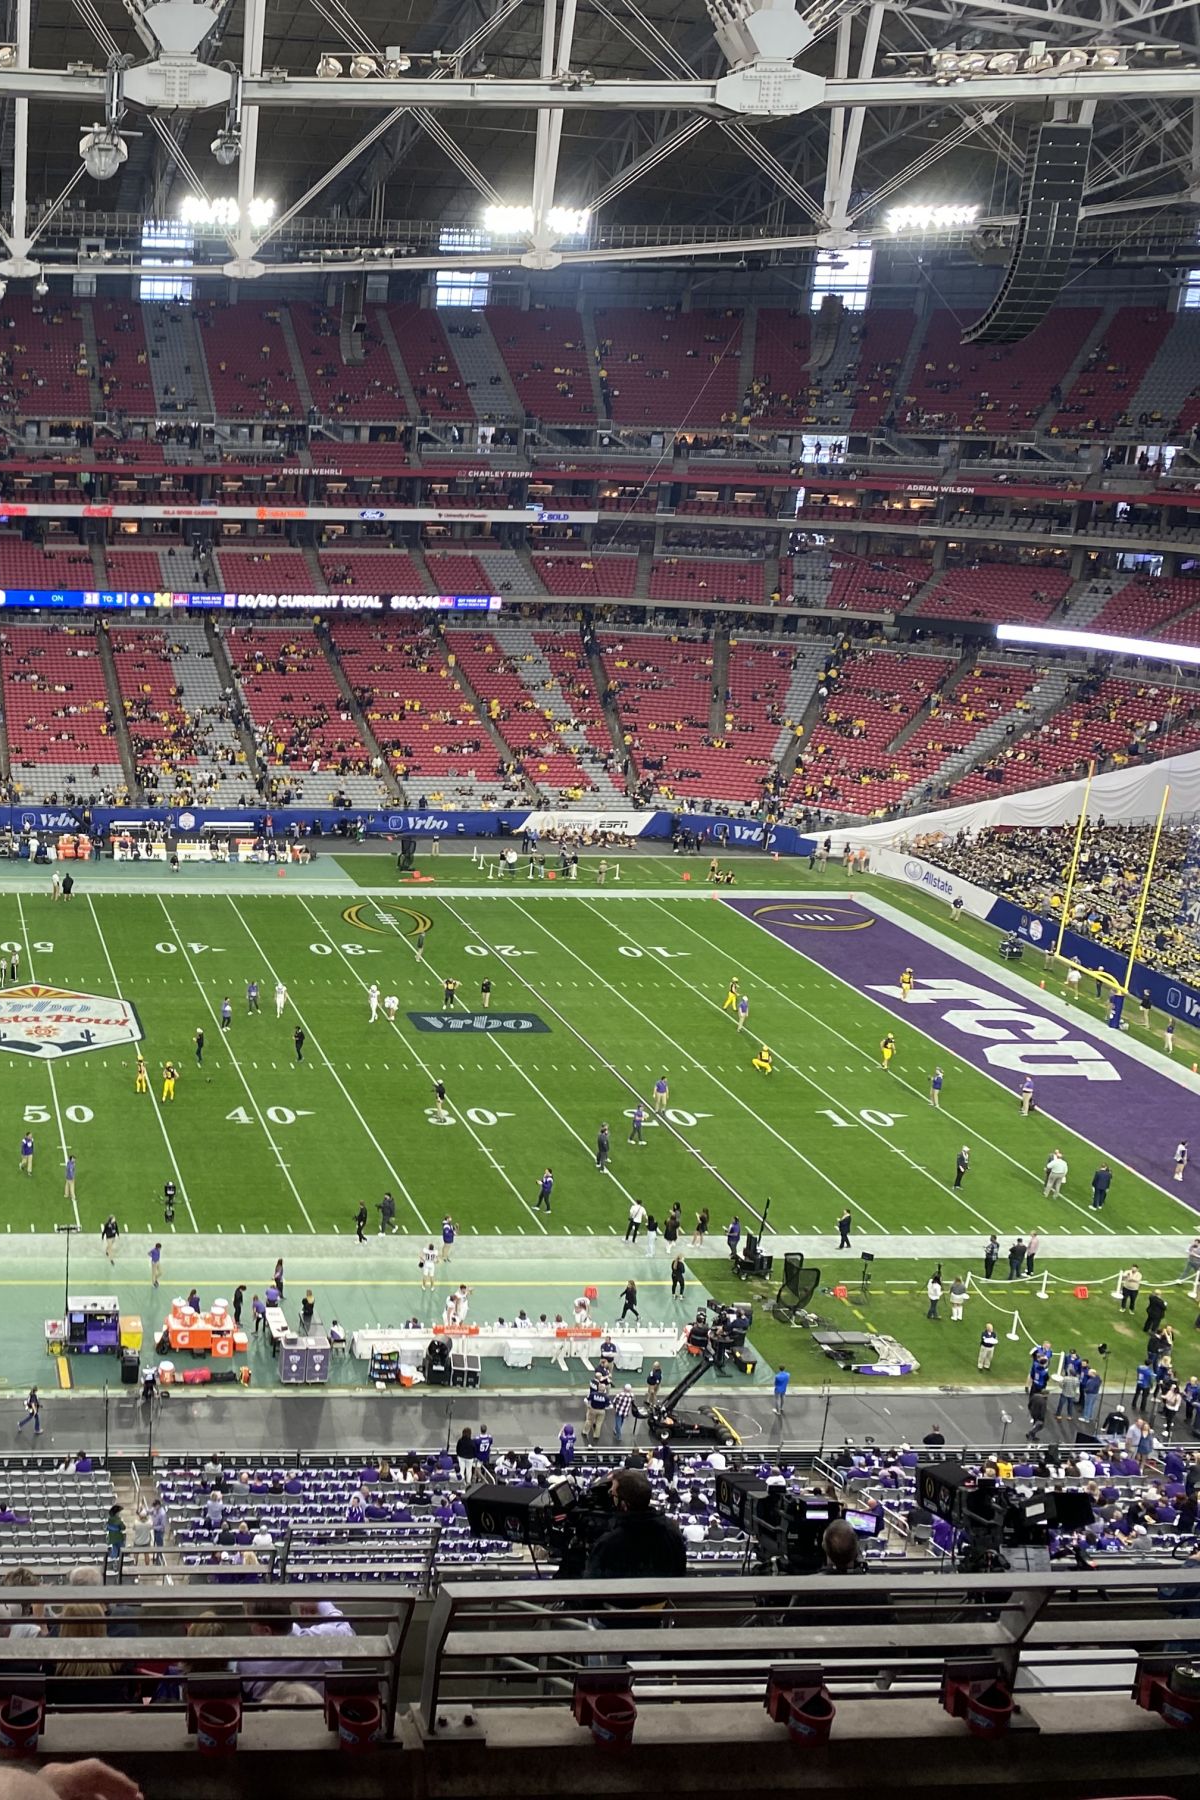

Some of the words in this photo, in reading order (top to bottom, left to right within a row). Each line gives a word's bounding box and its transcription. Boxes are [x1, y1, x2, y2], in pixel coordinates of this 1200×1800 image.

[906, 484, 938, 492] ADRIAN
[363, 511, 382, 519] Ford
[51, 594, 64, 602] ON
[237, 594, 277, 608] 50/50
[278, 595, 340, 608] CURRENT
[341, 595, 383, 608] TOTAL
[407, 815, 449, 830] Vrbo
[598, 820, 629, 829] ESPN
[922, 871, 953, 896] Allstate
[0, 941, 55, 953] 50
[155, 941, 210, 955] 40
[309, 943, 367, 956] 30
[464, 944, 523, 957] 20
[618, 945, 683, 959] 10
[46, 1014, 131, 1027] Bowl
[421, 1015, 534, 1029] Vrbo
[864, 978, 1122, 1081] TCU
[22, 1105, 95, 1124] 50
[225, 1106, 296, 1125] 40
[423, 1107, 499, 1127] 30
[815, 1109, 895, 1128] 10
[177, 1331, 189, 1345] G
[217, 1341, 229, 1354] G
